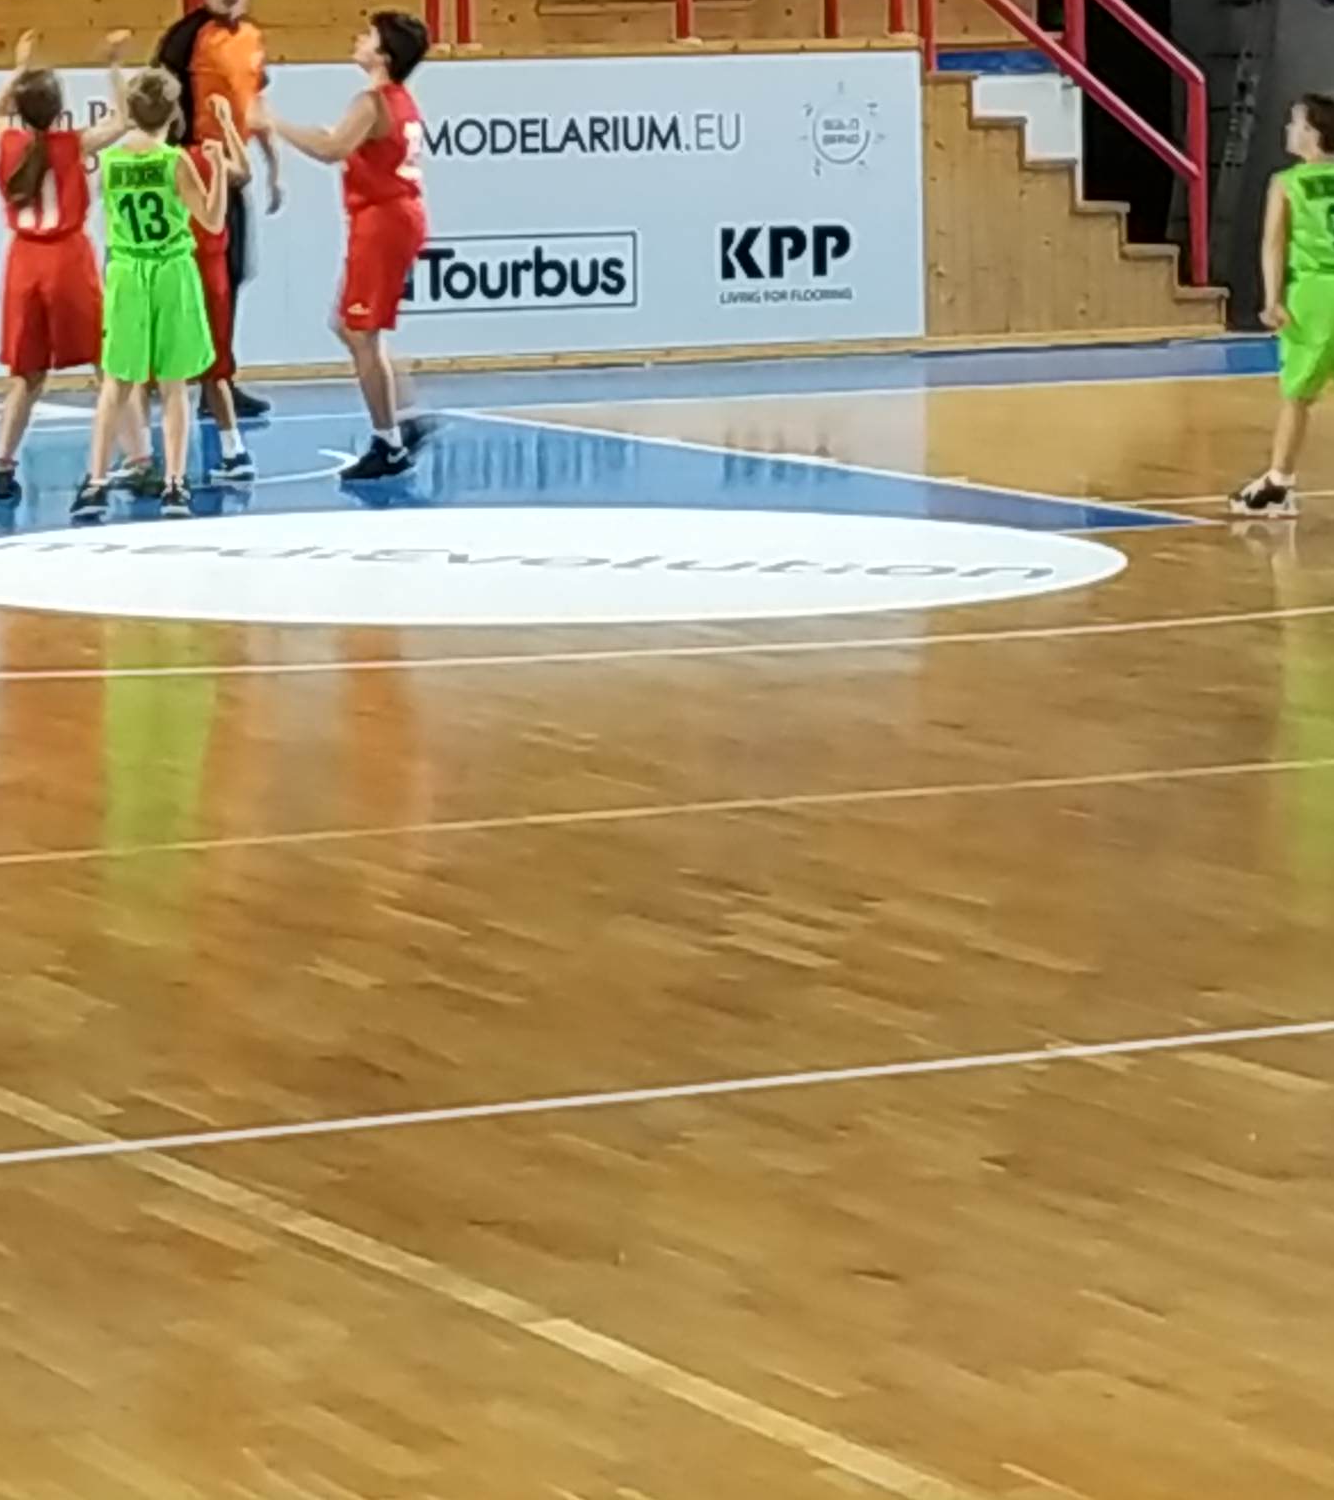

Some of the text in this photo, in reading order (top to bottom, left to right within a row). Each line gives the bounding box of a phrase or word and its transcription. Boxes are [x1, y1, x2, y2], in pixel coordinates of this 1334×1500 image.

[421, 112, 741, 156] MODELARIUM.EU
[118, 190, 170, 244] 13
[420, 245, 627, 301] Tourbus
[721, 225, 851, 279] KPP
